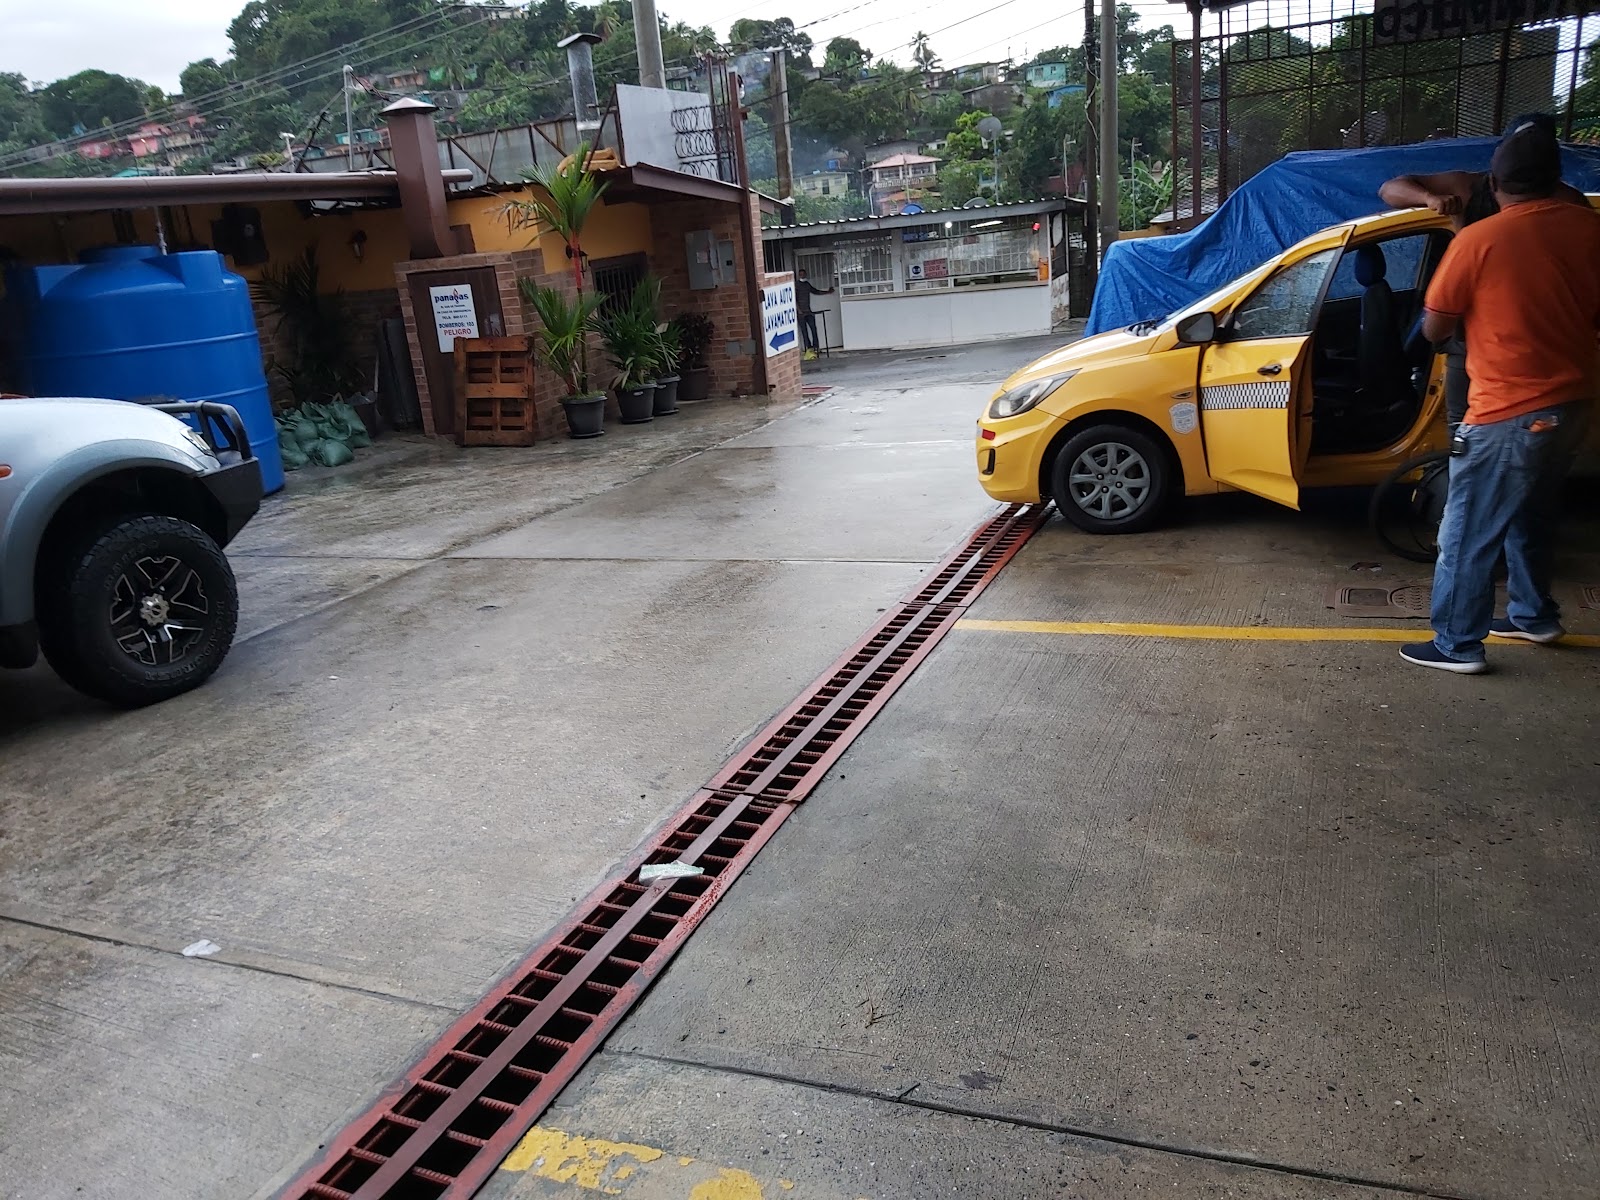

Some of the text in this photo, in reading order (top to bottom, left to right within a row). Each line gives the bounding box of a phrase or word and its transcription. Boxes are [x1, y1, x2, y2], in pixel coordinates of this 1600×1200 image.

[765, 286, 793, 310] LAVA AUTO
[443, 328, 472, 336] PELIGRO
[765, 307, 796, 333] LAVAMATICO
